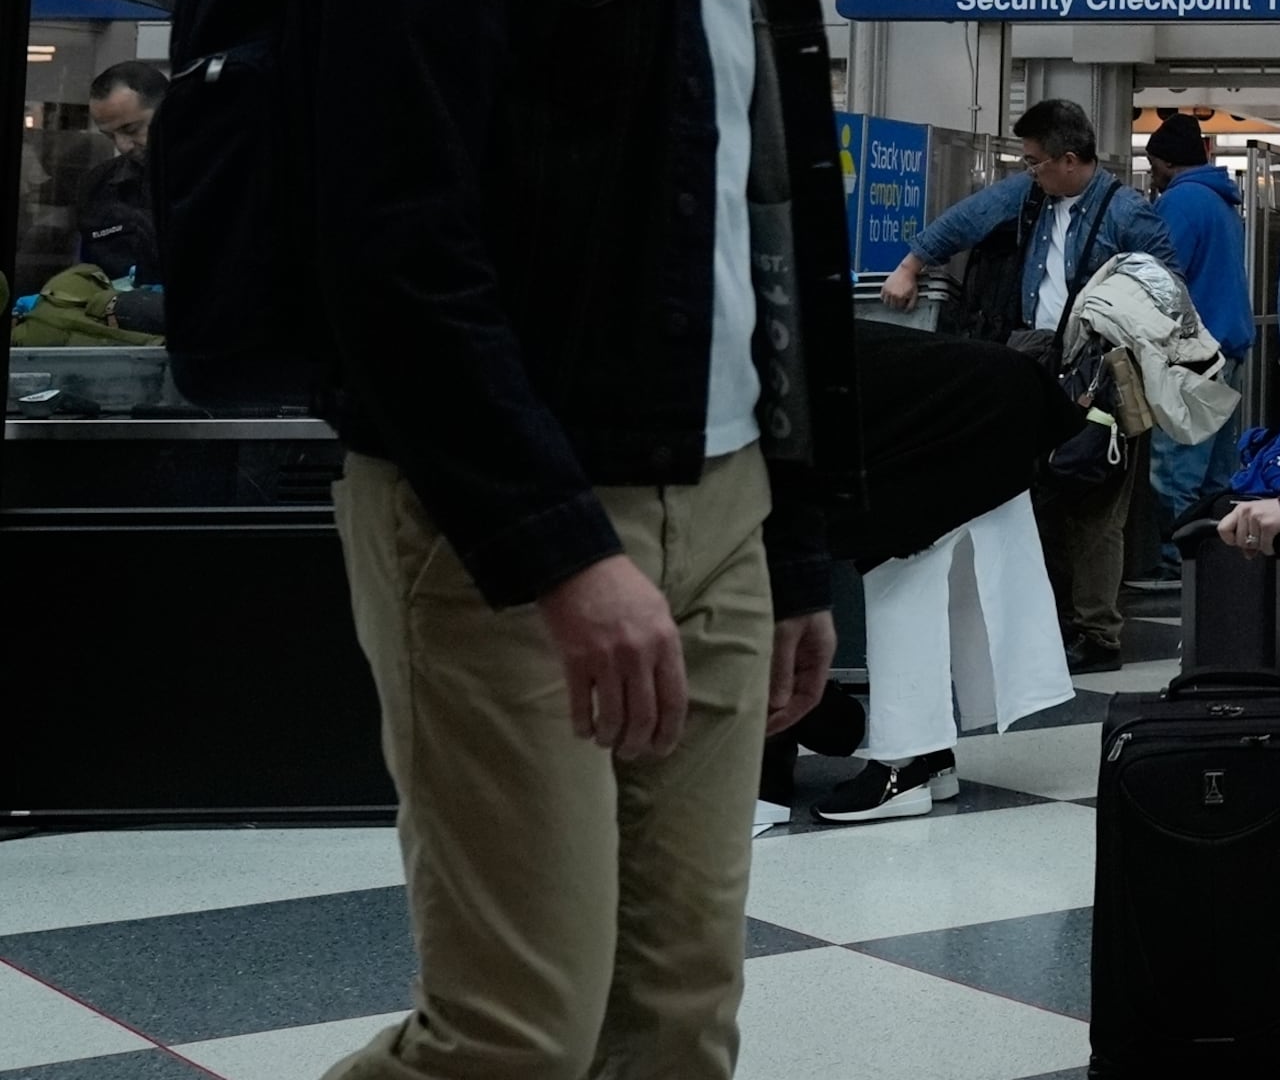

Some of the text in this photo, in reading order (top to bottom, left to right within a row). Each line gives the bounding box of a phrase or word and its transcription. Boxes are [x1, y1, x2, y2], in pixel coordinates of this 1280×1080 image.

[870, 140, 922, 176] Stack your
[869, 179, 920, 212] empty bin
[869, 214, 918, 242] to the left
